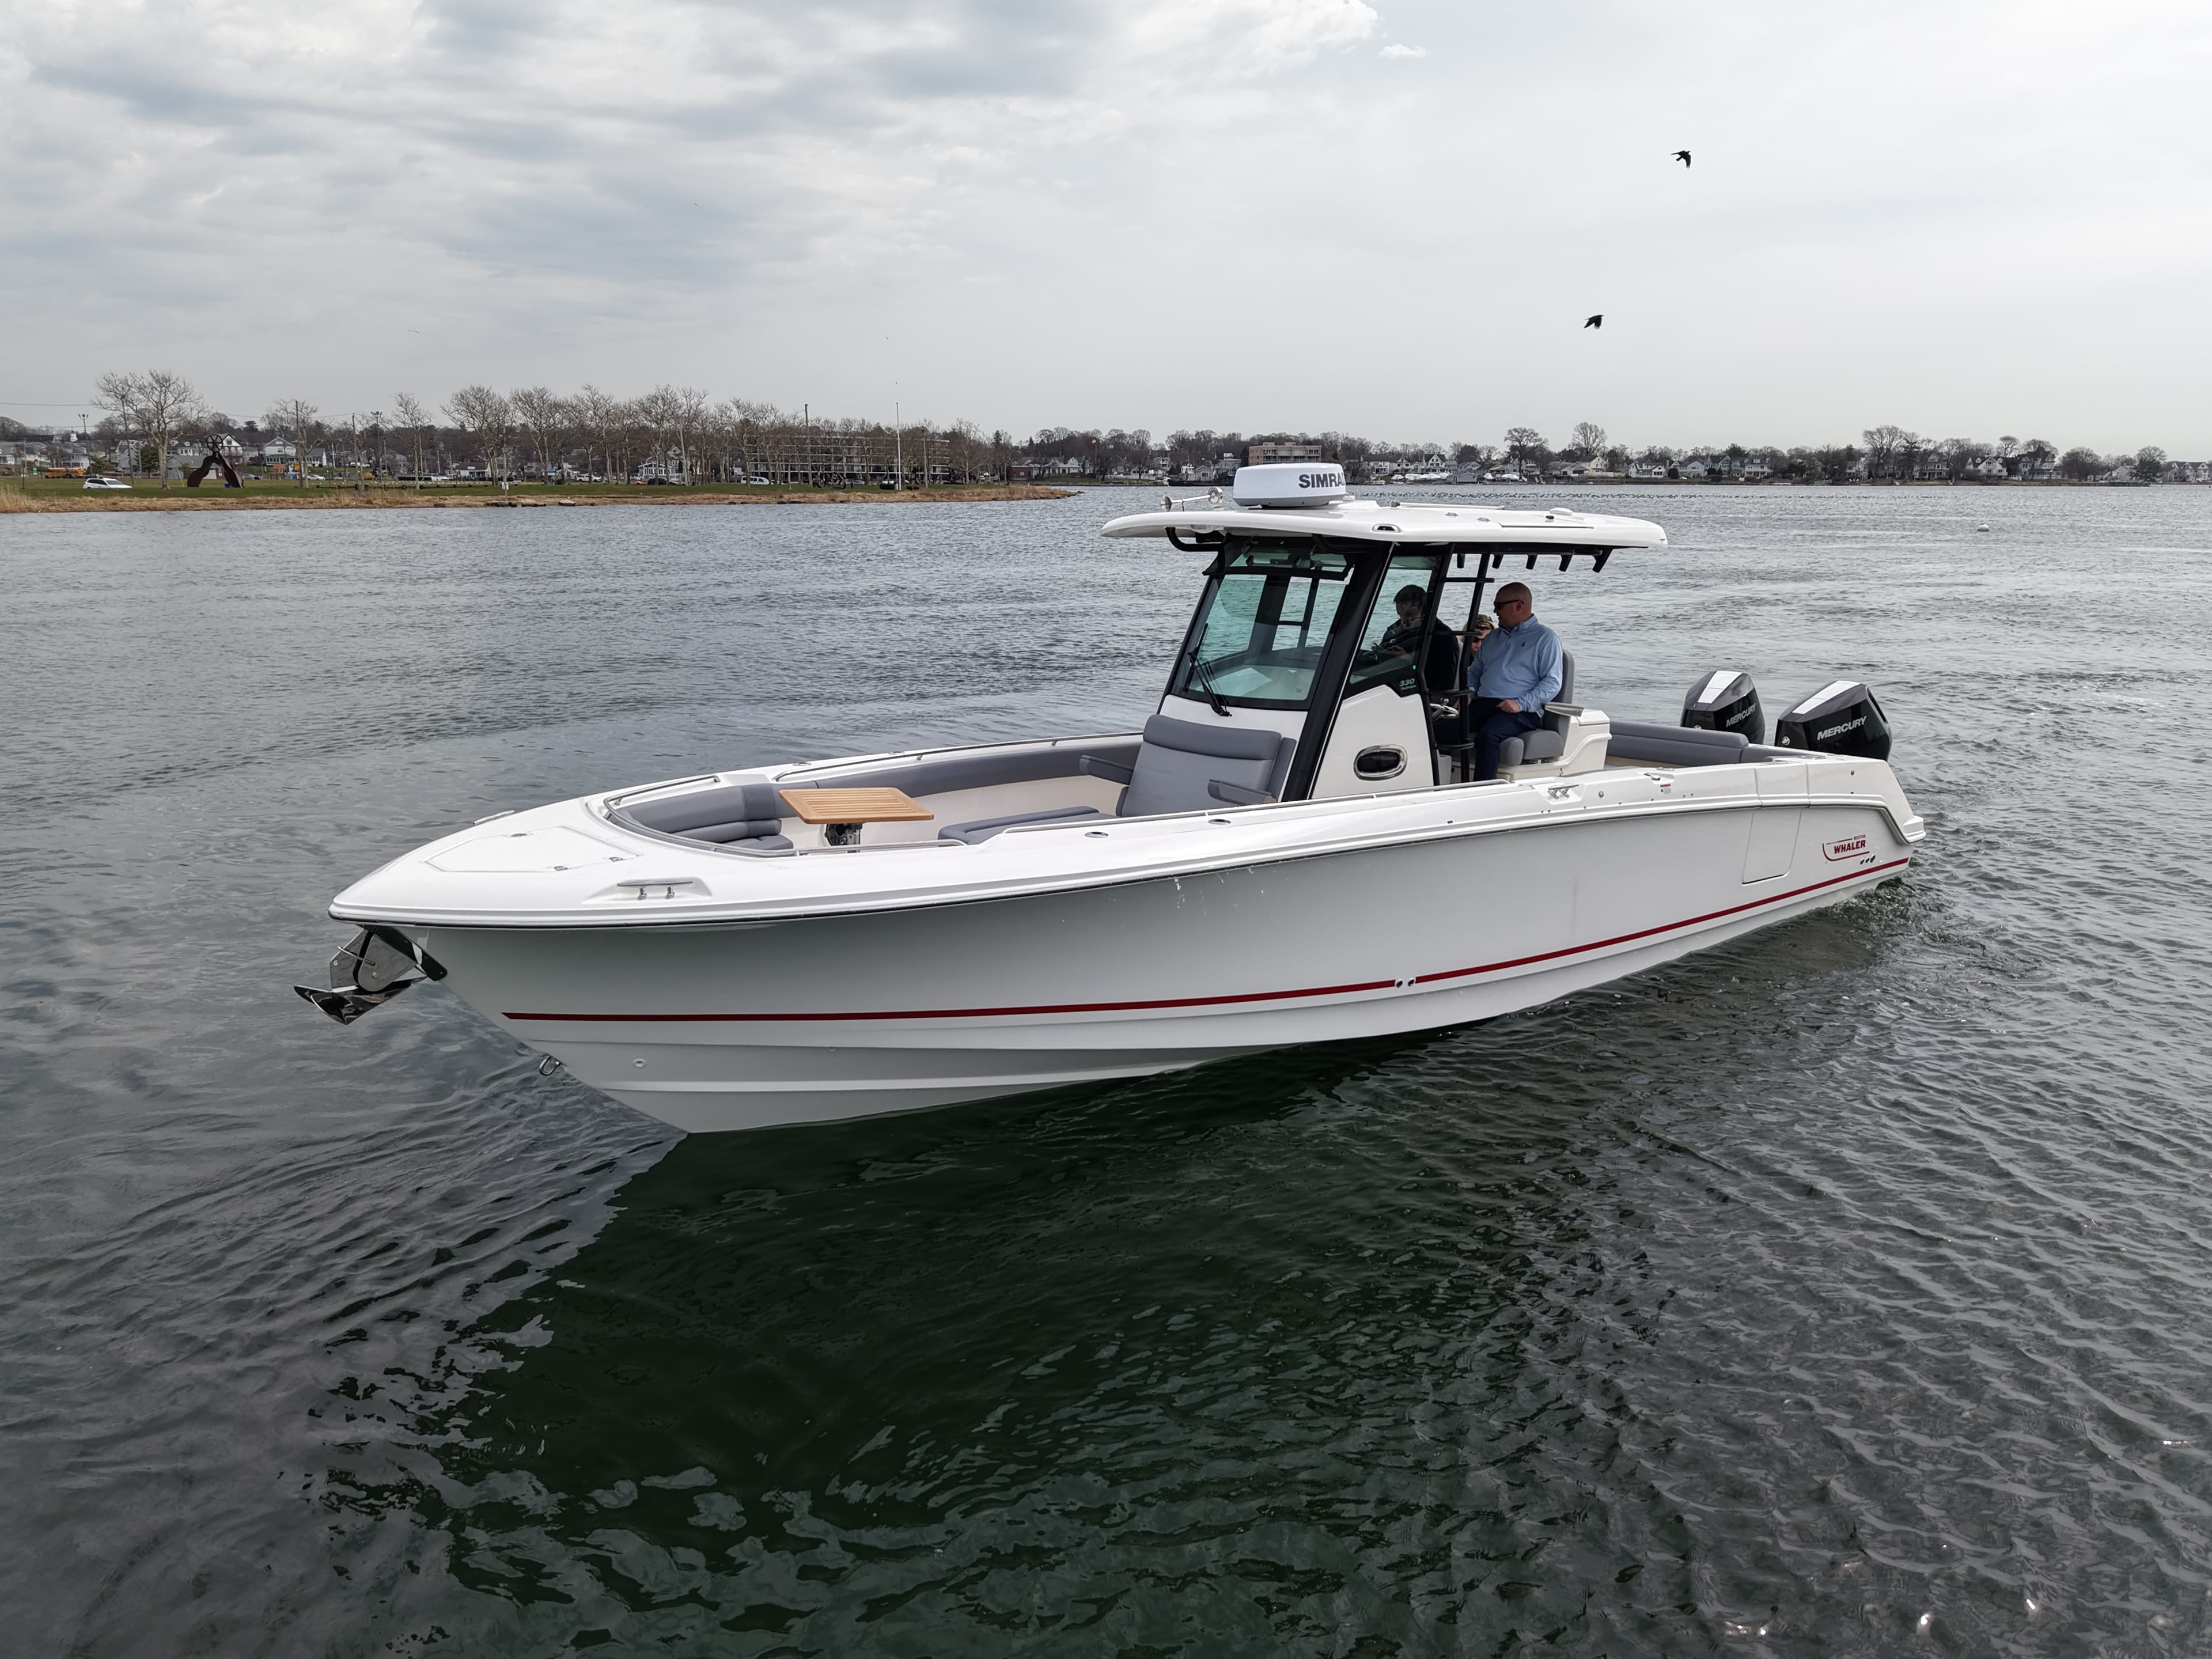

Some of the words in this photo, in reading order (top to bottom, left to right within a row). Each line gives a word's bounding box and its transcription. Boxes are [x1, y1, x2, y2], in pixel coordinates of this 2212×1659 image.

[1298, 472, 1344, 488] SIMRA
[1726, 703, 1756, 728] MERCURY
[1817, 715, 1867, 740] MERCURY
[1834, 840, 1866, 854] WHALER
